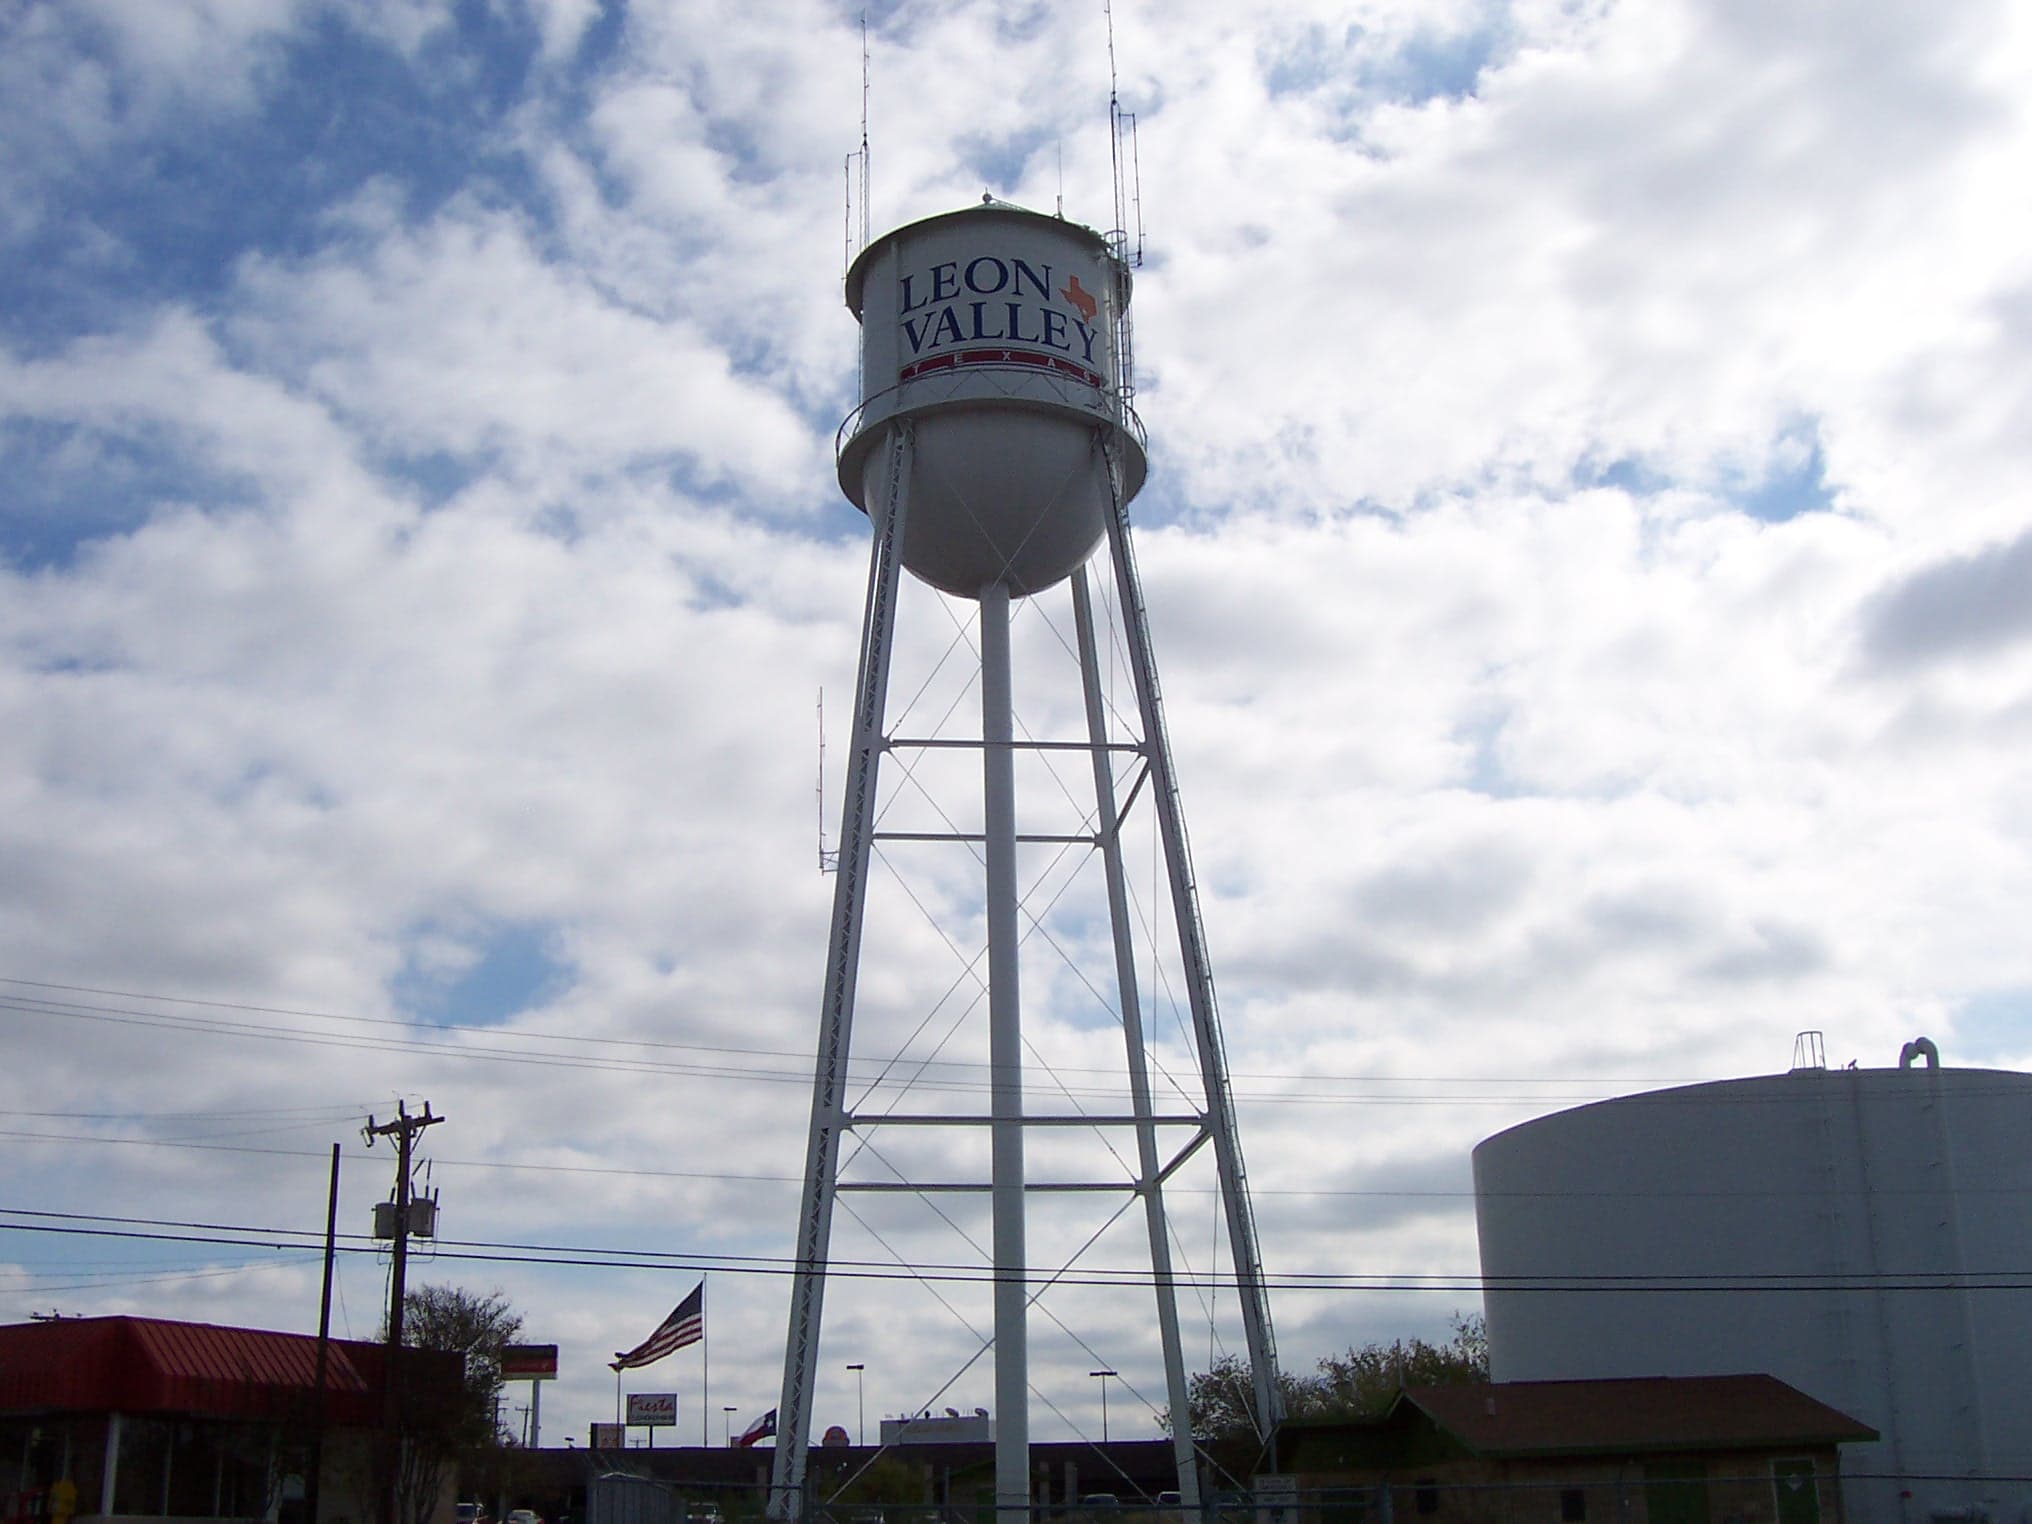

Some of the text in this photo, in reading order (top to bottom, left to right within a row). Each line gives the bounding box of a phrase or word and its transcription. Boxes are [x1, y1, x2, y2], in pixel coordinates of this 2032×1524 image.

[900, 256, 1052, 315] LEON
[900, 301, 1098, 364] VALLEY
[912, 351, 1091, 382] TEXAS
[630, 1395, 673, 1413] Fiesta
